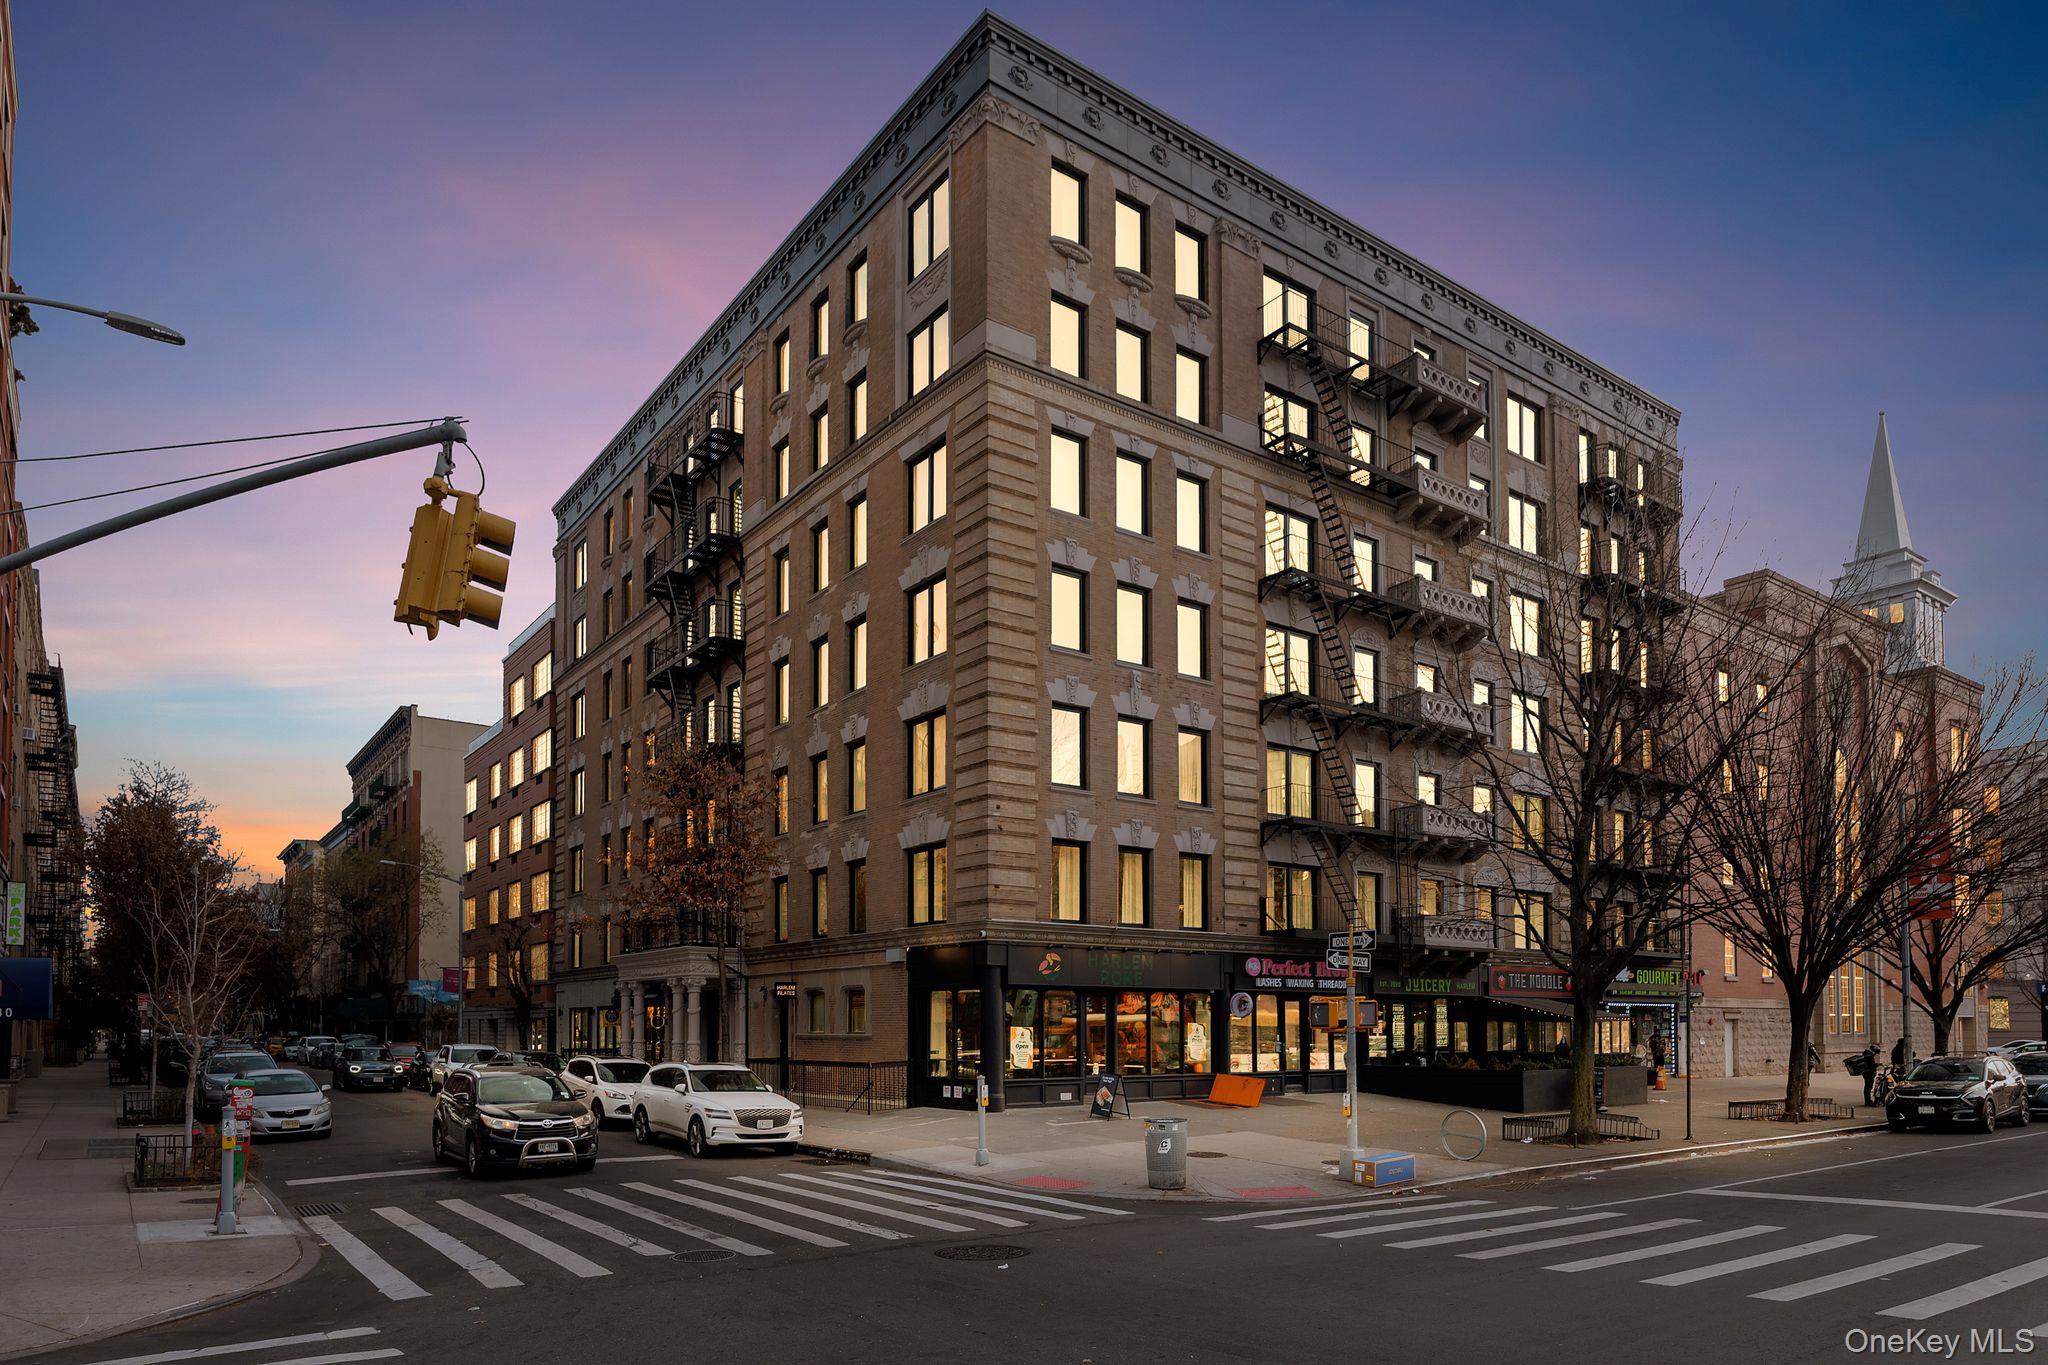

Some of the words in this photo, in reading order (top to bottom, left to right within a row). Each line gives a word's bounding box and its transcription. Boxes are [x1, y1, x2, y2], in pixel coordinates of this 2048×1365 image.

[1335, 938, 1349, 946] ONE
[1354, 936, 1369, 945] WAY
[1087, 951, 1153, 969] HARLEM
[1262, 958, 1311, 977] Perfect
[1333, 956, 1347, 965] ONE
[1353, 958, 1367, 966] WAY
[1099, 970, 1145, 986] POKE
[1256, 978, 1282, 987] LASHES
[1287, 979, 1314, 988] WAXING
[1508, 973, 1527, 989] THE
[1529, 974, 1563, 990] NOODLE
[1637, 969, 1680, 985] GOURMET
[1405, 979, 1452, 992] JUICERY
